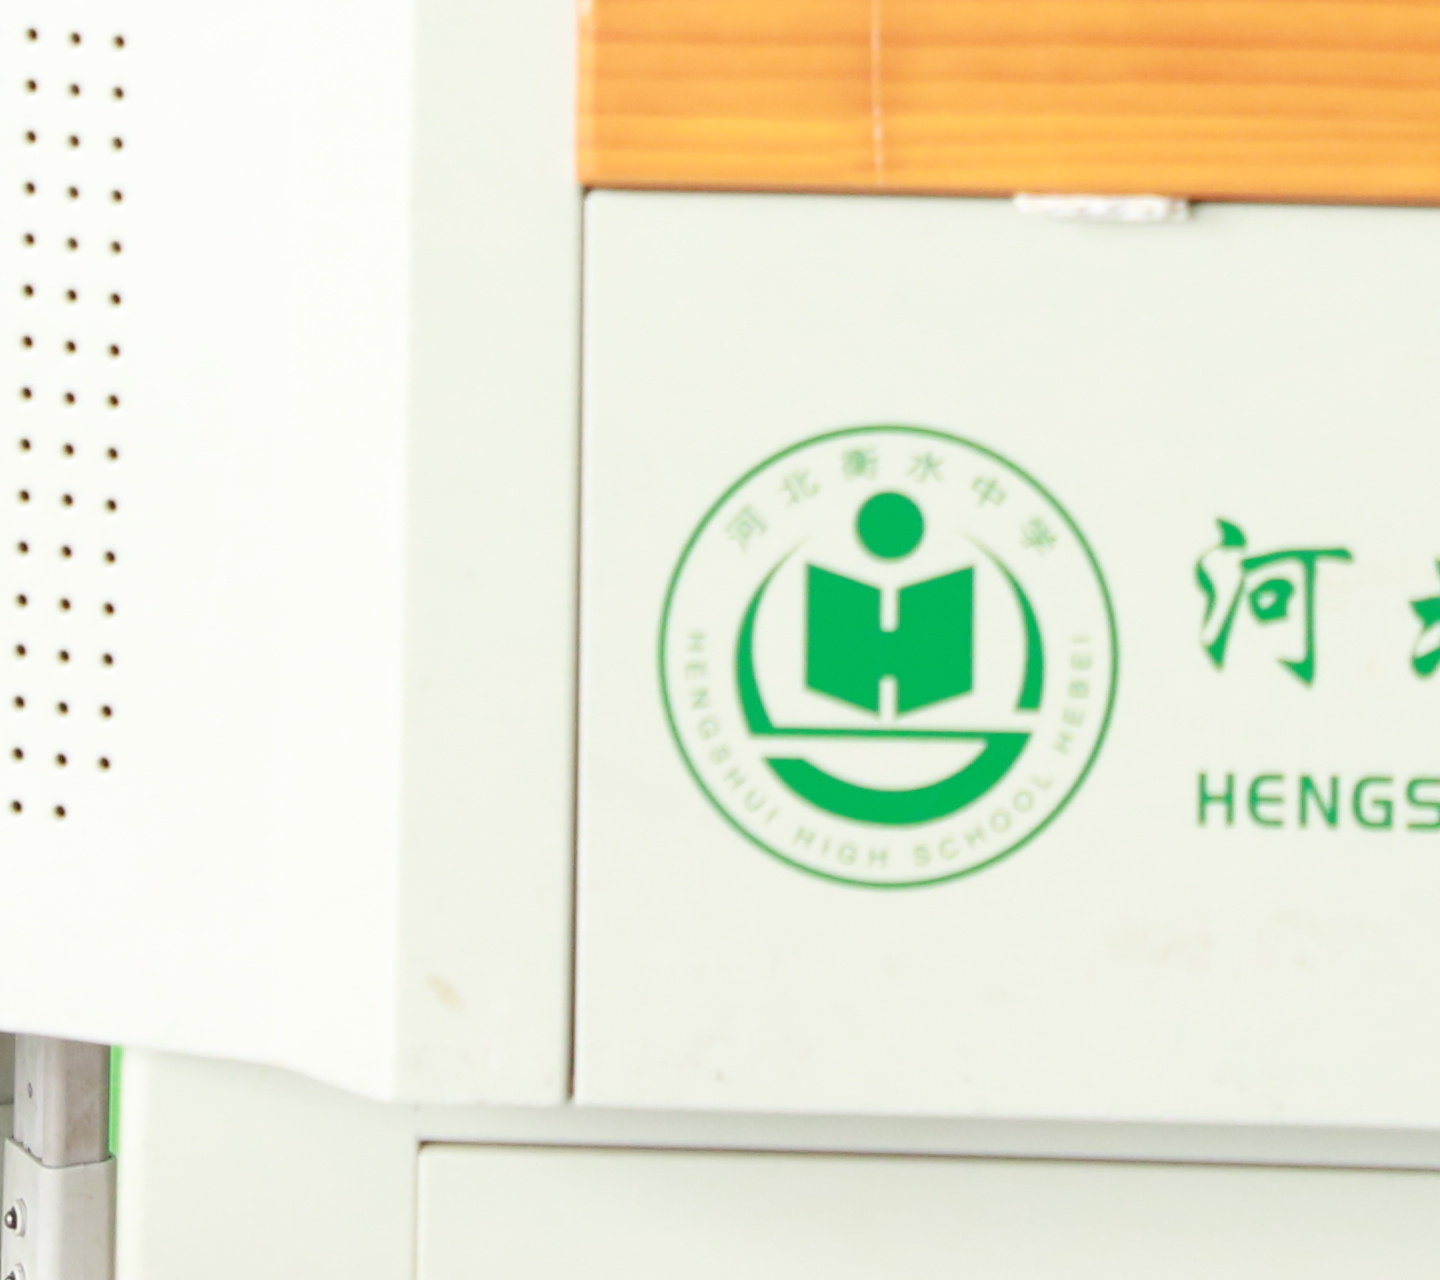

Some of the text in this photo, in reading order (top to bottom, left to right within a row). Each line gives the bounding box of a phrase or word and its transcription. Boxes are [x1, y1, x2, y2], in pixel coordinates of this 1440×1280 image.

[720, 445, 1062, 558] 河北衡水中学
[686, 629, 1094, 870] HENGSHUI HIGH SCHOOL HEBEI
